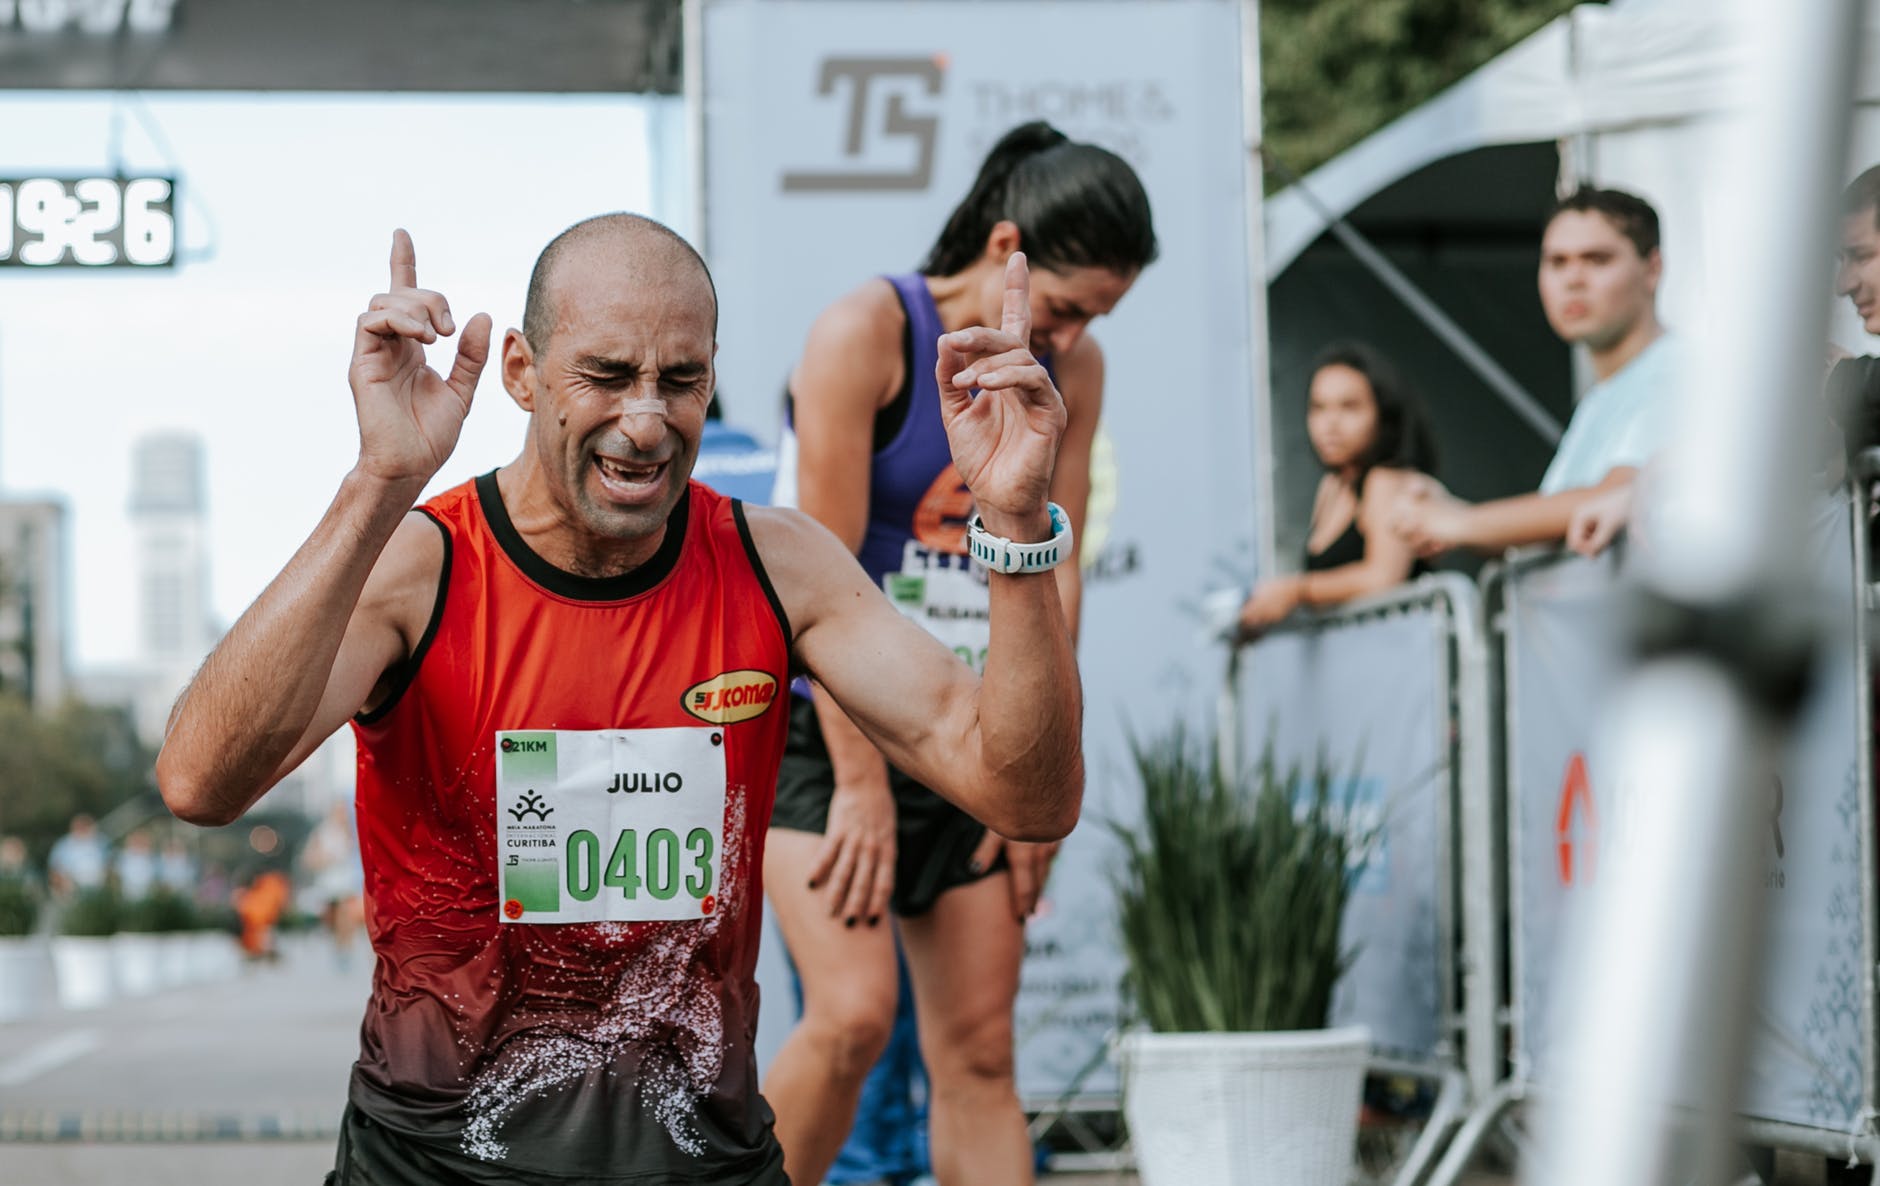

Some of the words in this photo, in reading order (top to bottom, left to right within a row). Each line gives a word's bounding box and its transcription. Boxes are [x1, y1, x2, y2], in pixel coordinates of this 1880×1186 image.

[511, 741, 547, 752] 21KM
[606, 772, 683, 794] JULIO
[507, 839, 556, 847] CURITIBA
[566, 827, 714, 902] 0403
